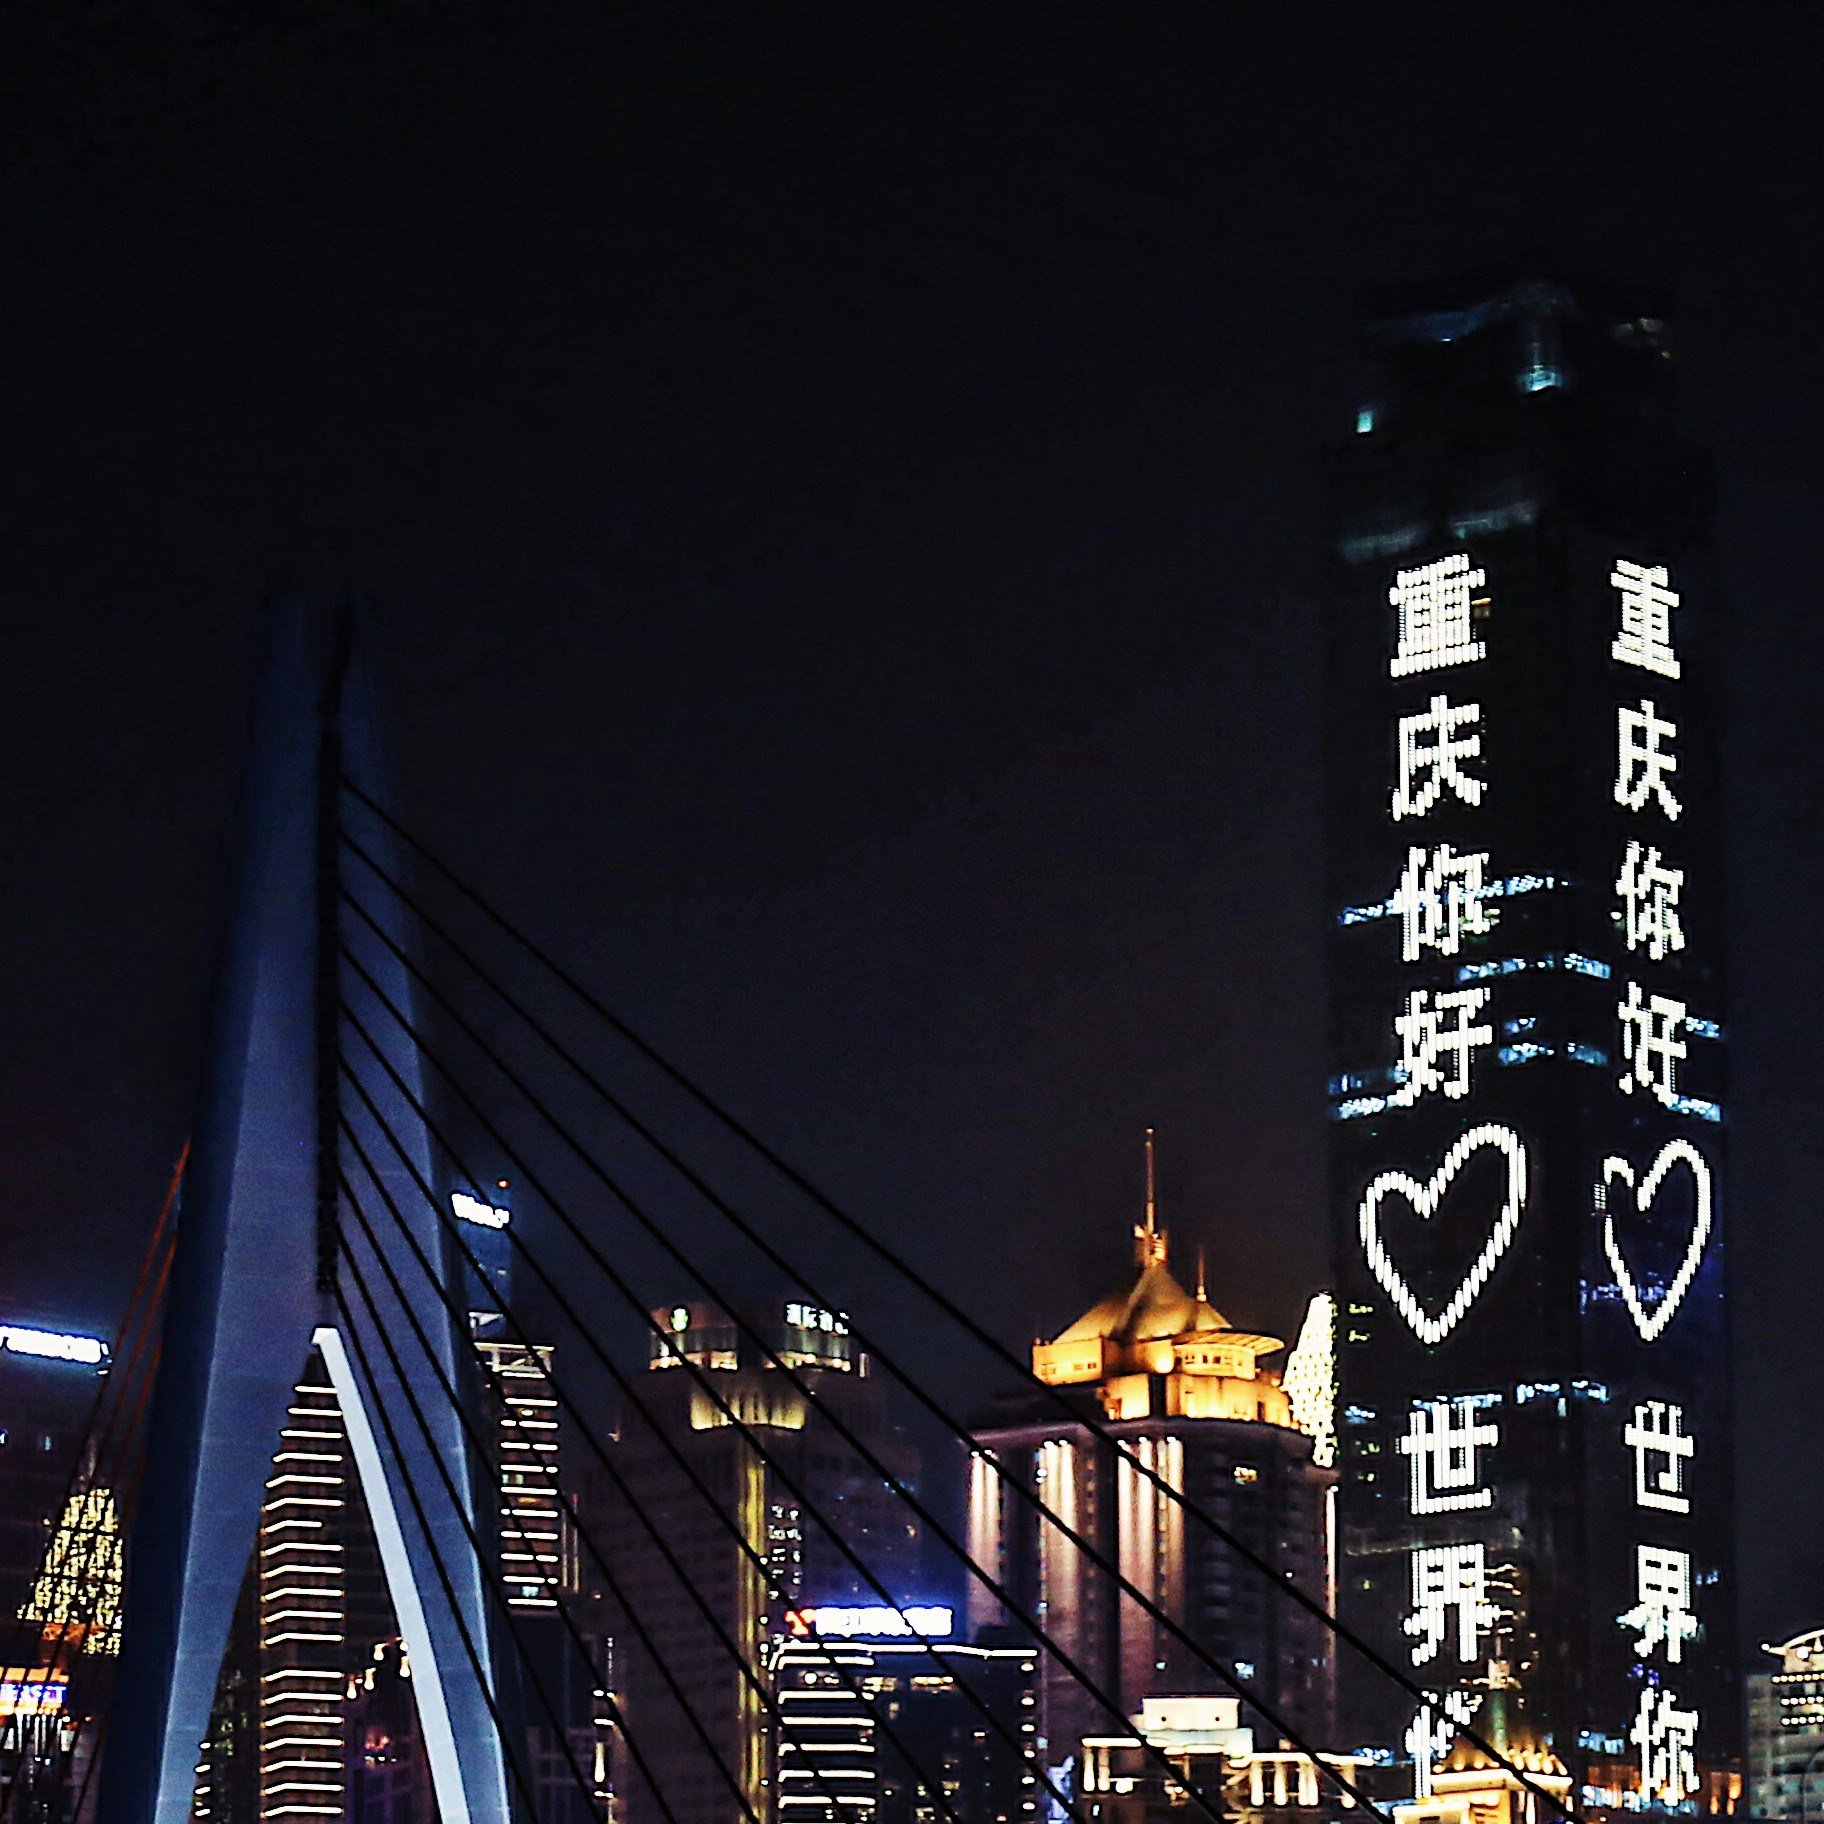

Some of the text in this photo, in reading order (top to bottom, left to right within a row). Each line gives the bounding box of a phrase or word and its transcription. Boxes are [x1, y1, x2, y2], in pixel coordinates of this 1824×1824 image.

[1387, 553, 1493, 1107] 重庆你好
[1608, 557, 1686, 1104] 重庆你好
